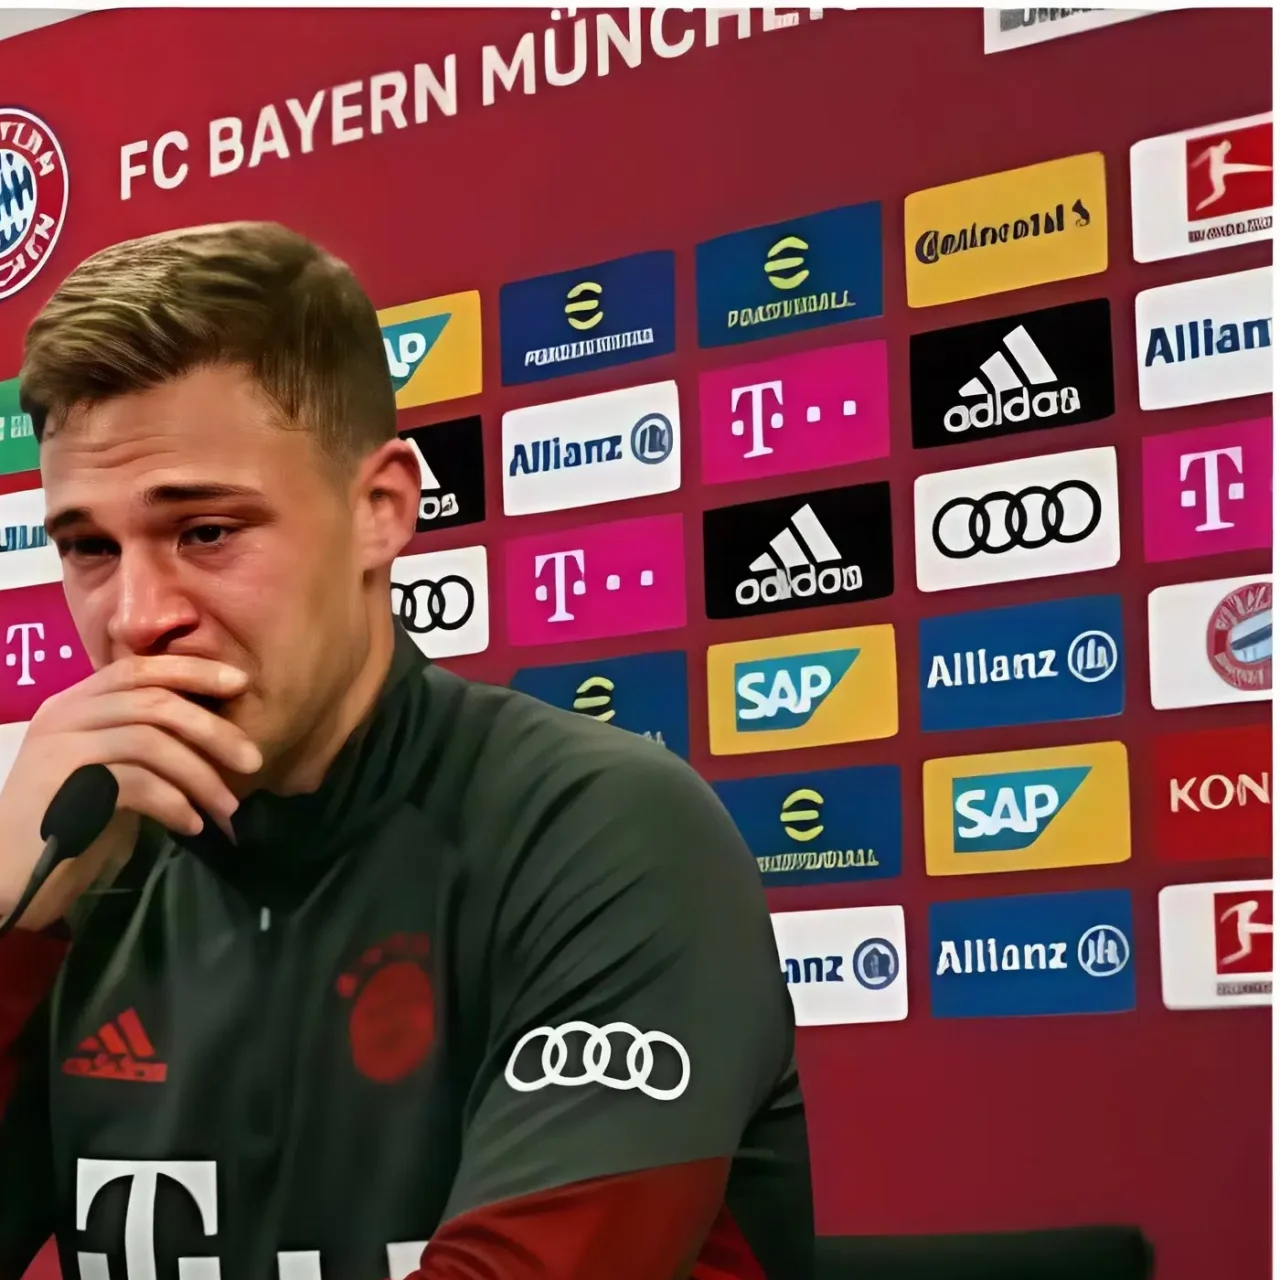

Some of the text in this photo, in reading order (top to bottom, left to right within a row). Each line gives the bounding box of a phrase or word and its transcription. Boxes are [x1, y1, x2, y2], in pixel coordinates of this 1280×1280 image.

[120, 8, 826, 200] FC BAYERN MÜNCH
[736, 664, 832, 720] SAP
[955, 783, 1060, 839] SAP
